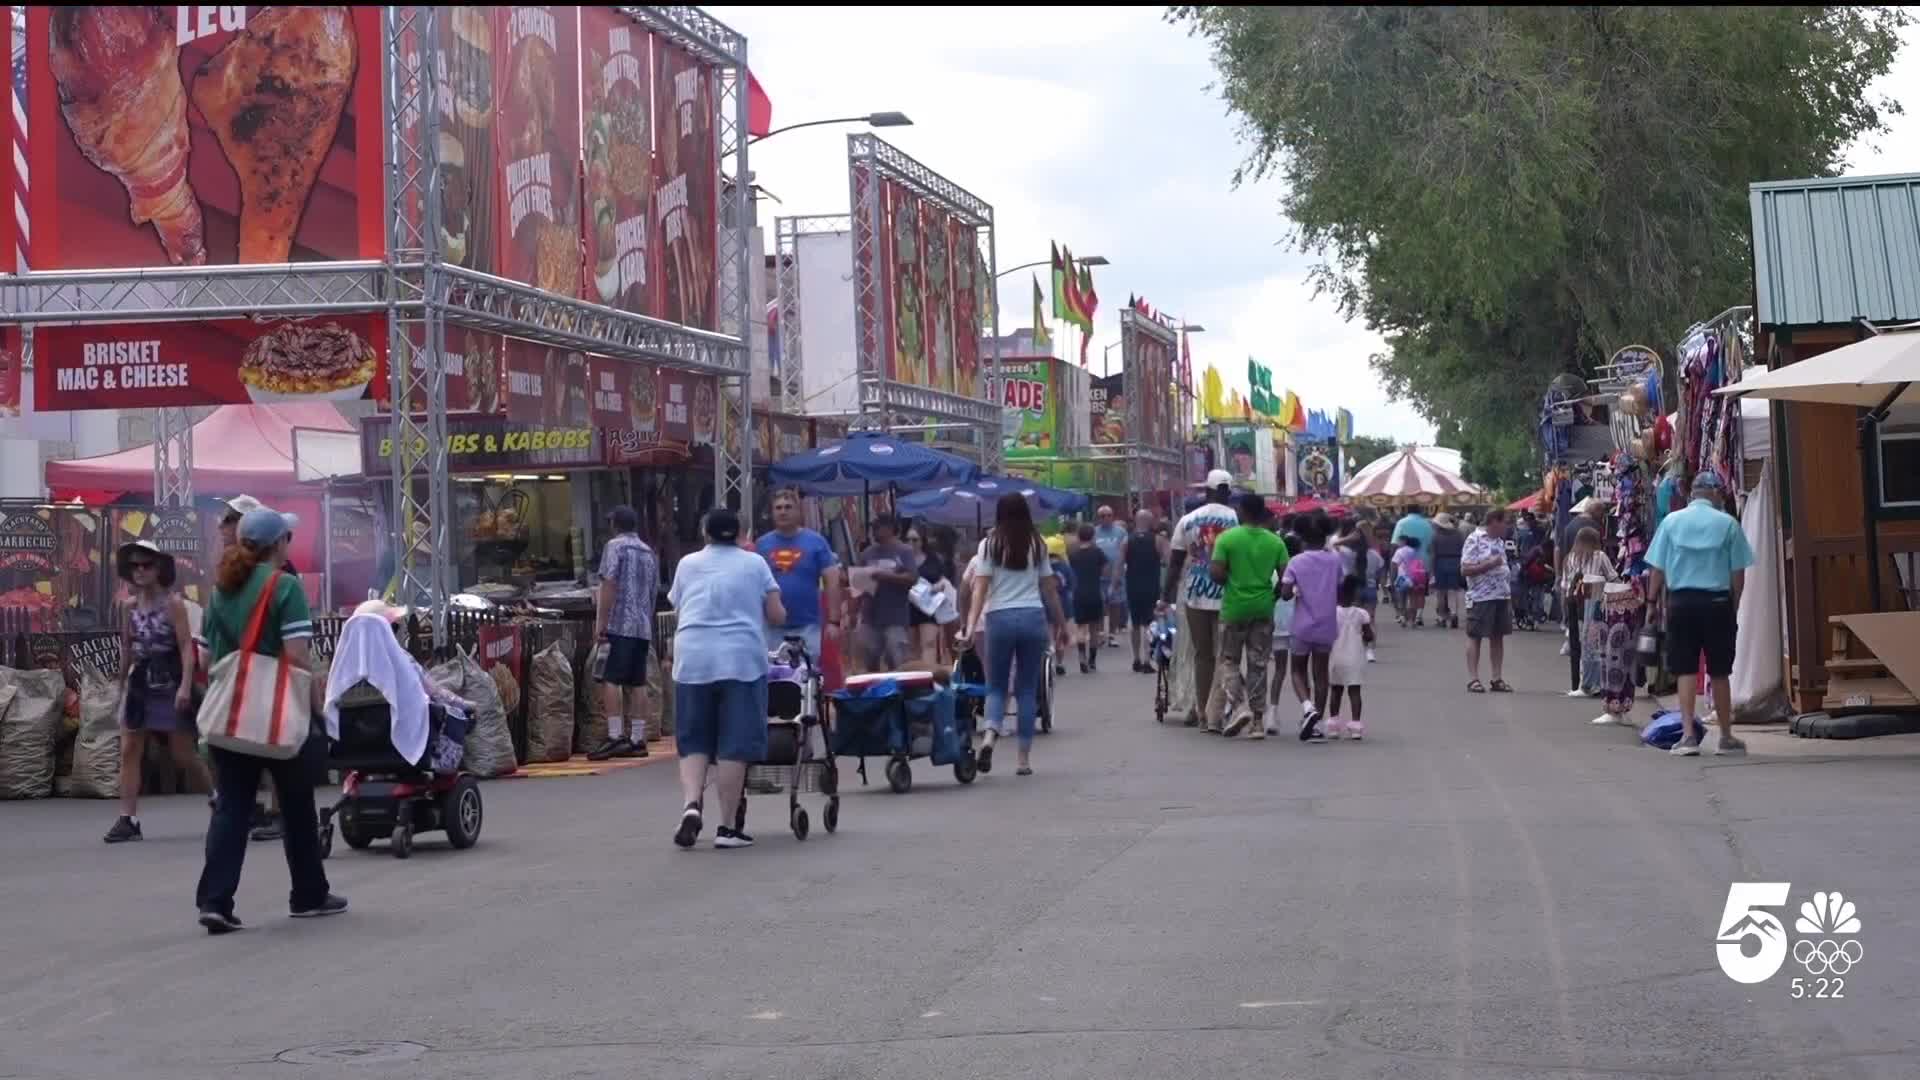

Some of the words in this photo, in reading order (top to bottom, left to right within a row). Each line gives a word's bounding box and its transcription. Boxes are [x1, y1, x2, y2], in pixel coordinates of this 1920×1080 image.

[176, 6, 246, 47] LEG
[83, 340, 161, 366] BRISKET
[57, 367, 99, 391] MAC
[103, 369, 117, 389] &
[121, 363, 189, 388] CHEESE
[1002, 378, 1047, 413] ADE
[1089, 387, 1107, 401] KEN
[485, 433, 497, 452] &
[503, 430, 591, 450] KABOBS
[70, 634, 121, 658] BACON
[71, 648, 121, 674] WRAPP
